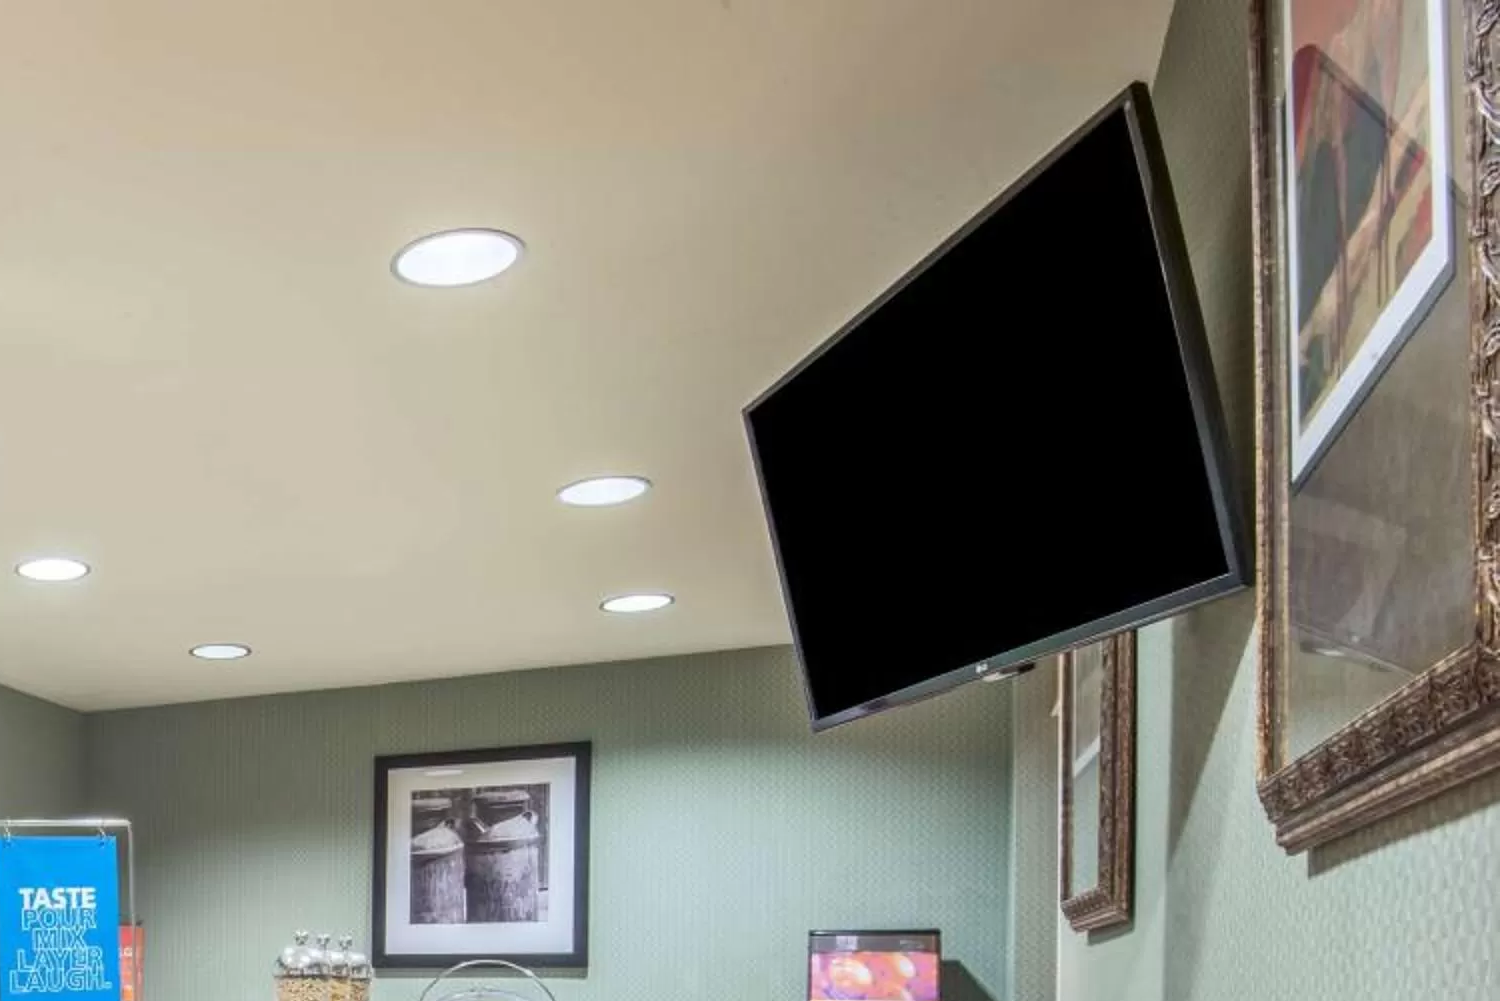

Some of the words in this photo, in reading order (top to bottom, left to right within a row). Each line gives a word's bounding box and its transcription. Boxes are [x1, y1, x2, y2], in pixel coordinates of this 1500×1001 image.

[17, 887, 97, 910] TASTE
[21, 907, 97, 931] POUR
[32, 926, 88, 951] MIX
[16, 946, 104, 973] LAYER
[9, 967, 113, 994] LAUGH.
